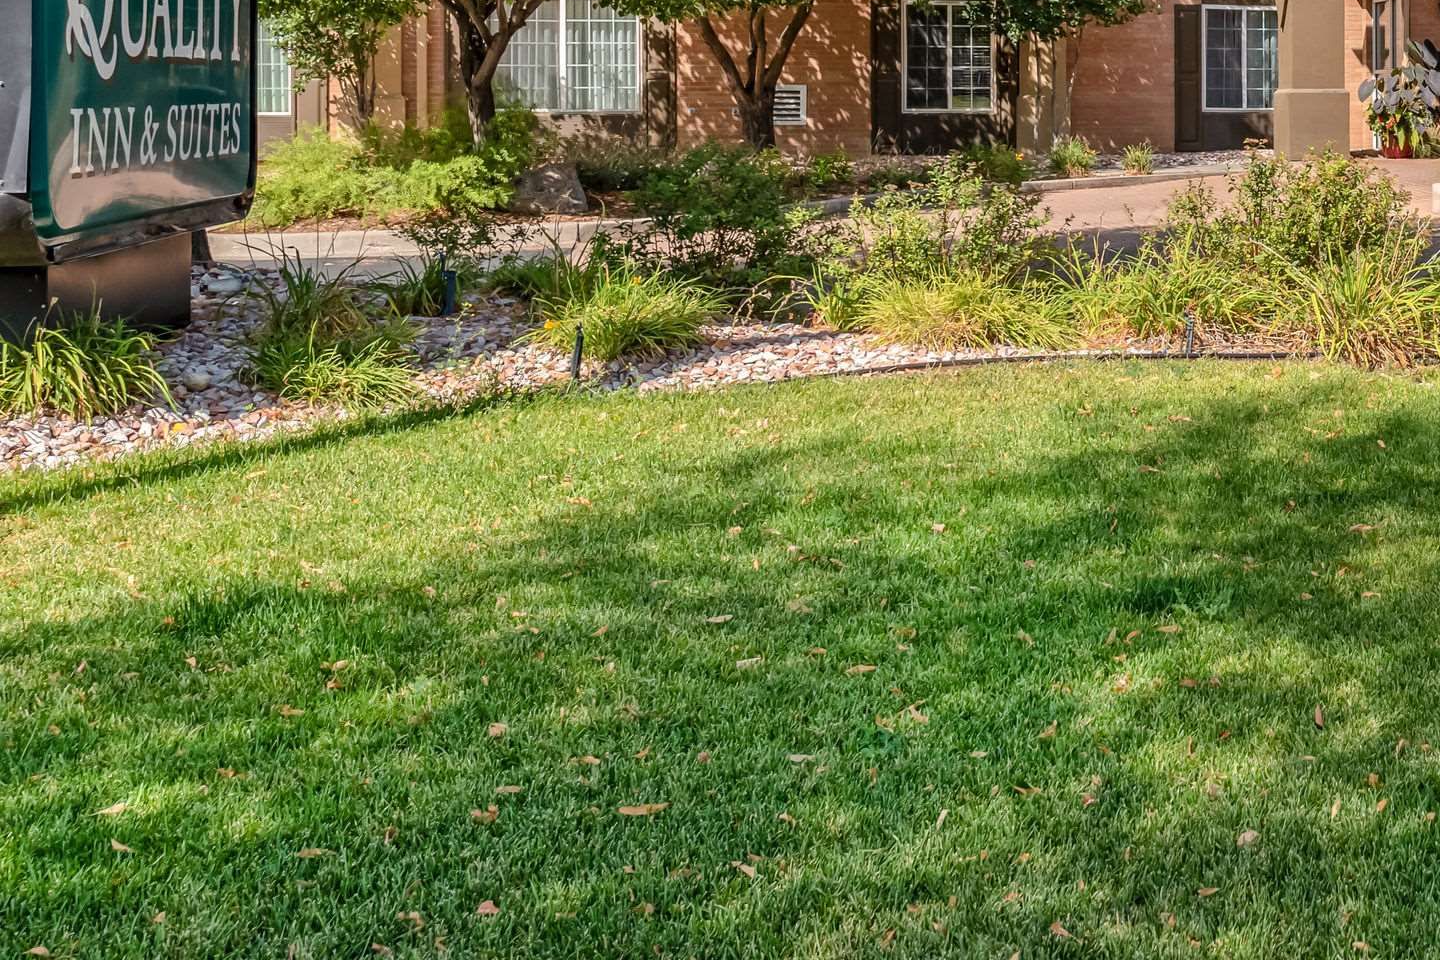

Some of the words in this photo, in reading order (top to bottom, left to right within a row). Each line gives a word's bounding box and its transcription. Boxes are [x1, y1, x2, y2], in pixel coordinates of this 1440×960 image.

[69, 107, 134, 174] INN
[140, 105, 160, 166] &
[164, 103, 242, 163] SUITES
